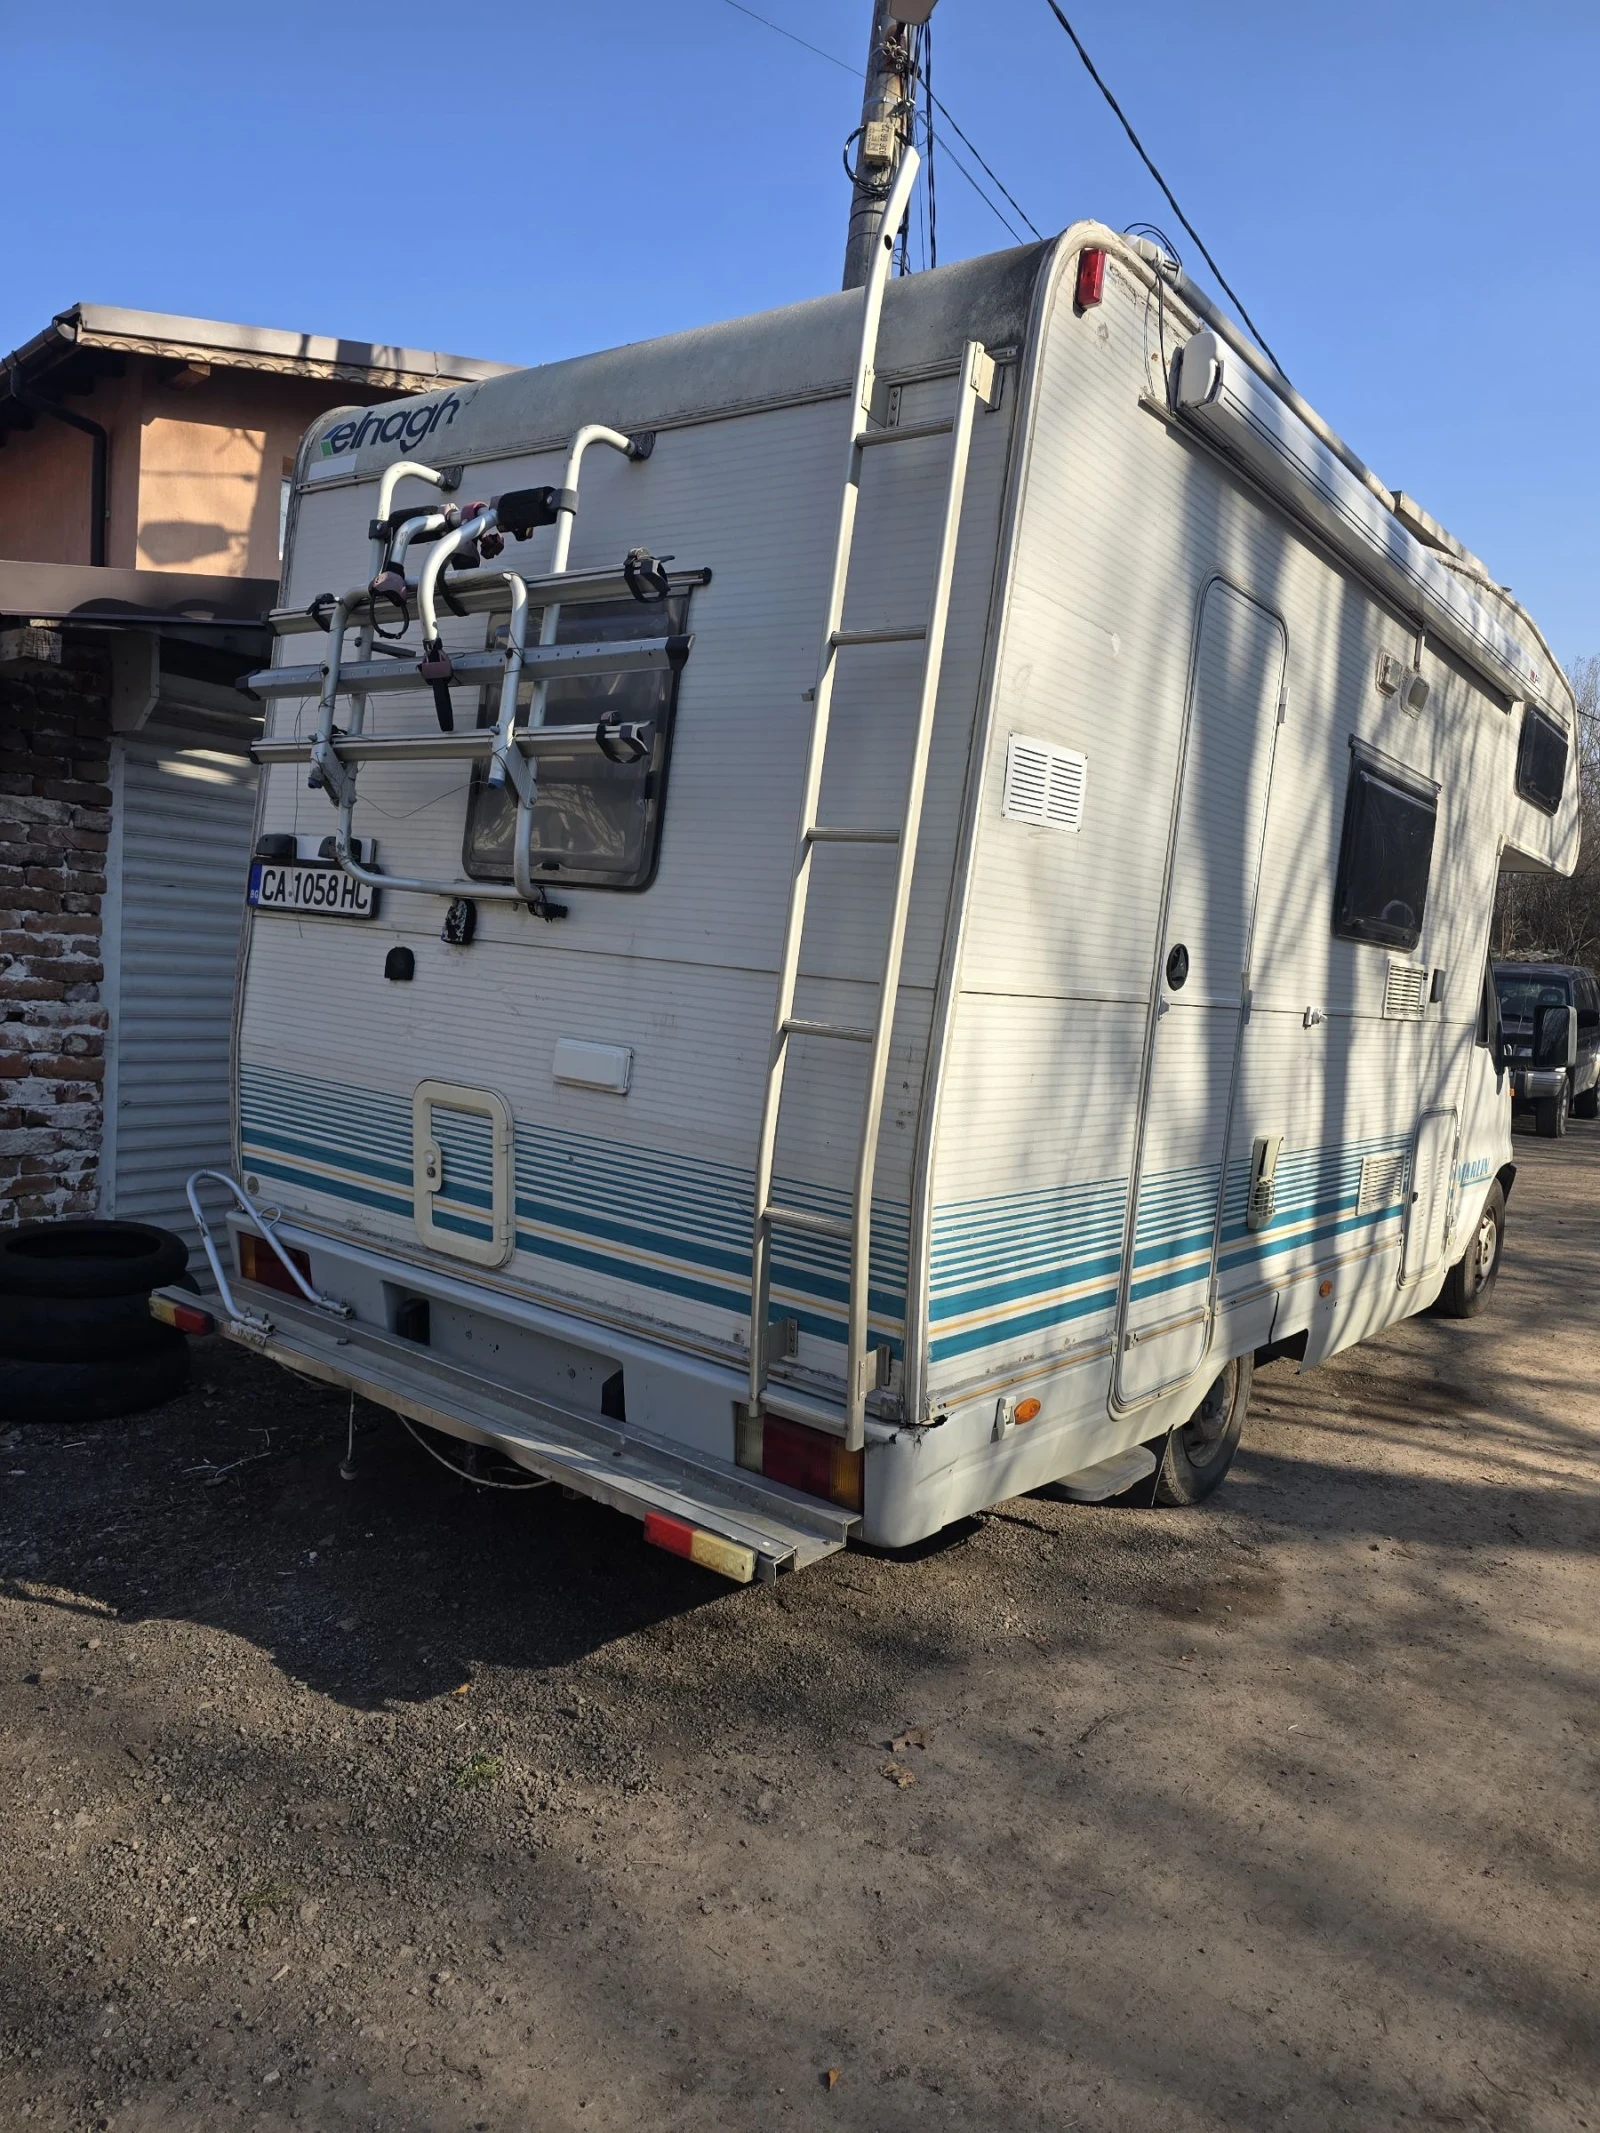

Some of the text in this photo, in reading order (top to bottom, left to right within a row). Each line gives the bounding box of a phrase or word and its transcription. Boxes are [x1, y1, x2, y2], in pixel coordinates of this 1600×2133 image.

[871, 127, 880, 151] NET
[329, 392, 460, 455] elnagh
[250, 889, 259, 899] BG
[262, 869, 368, 909] CA 1058 HC
